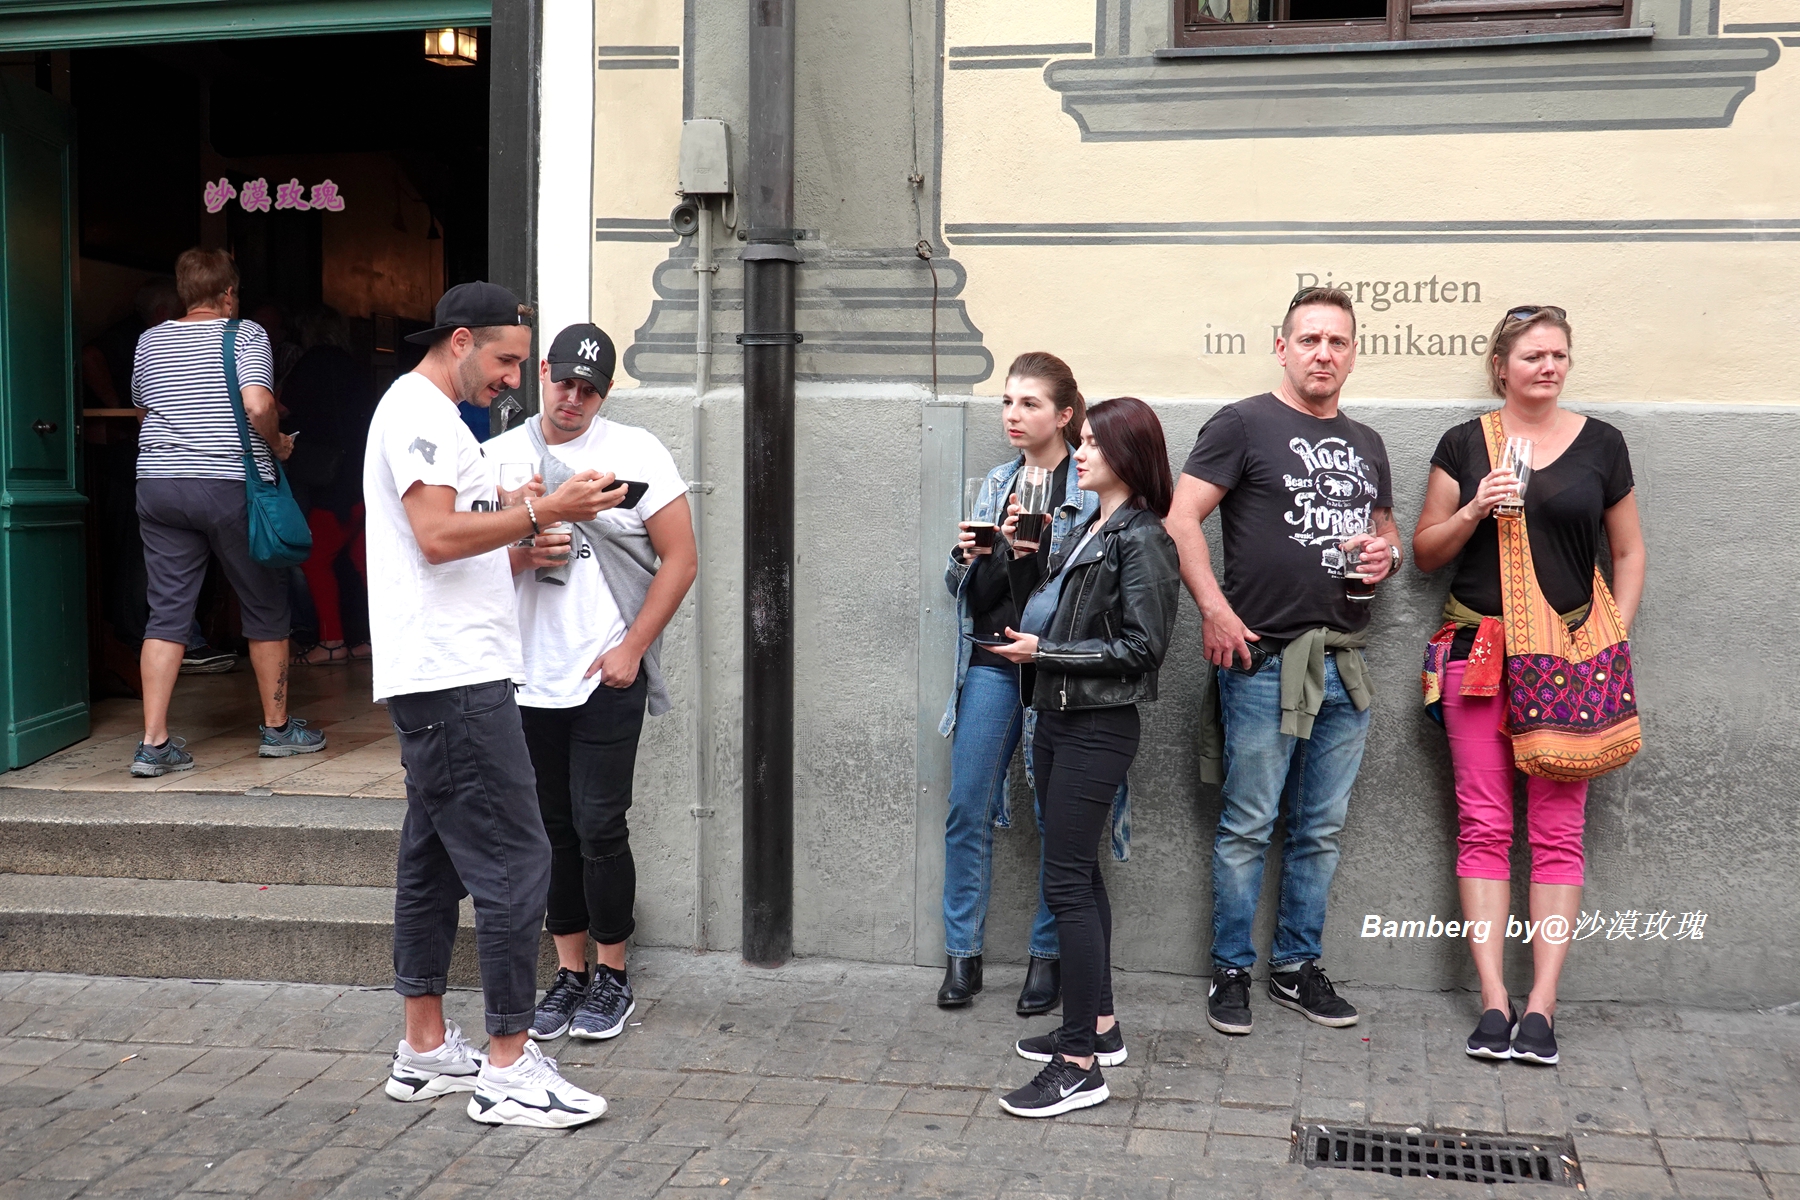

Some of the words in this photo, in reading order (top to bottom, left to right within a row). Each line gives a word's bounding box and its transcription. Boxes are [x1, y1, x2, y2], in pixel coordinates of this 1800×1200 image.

[577, 338, 600, 361] NY
[1204, 323, 1246, 354] im
[1283, 474, 1313, 491] Bears
